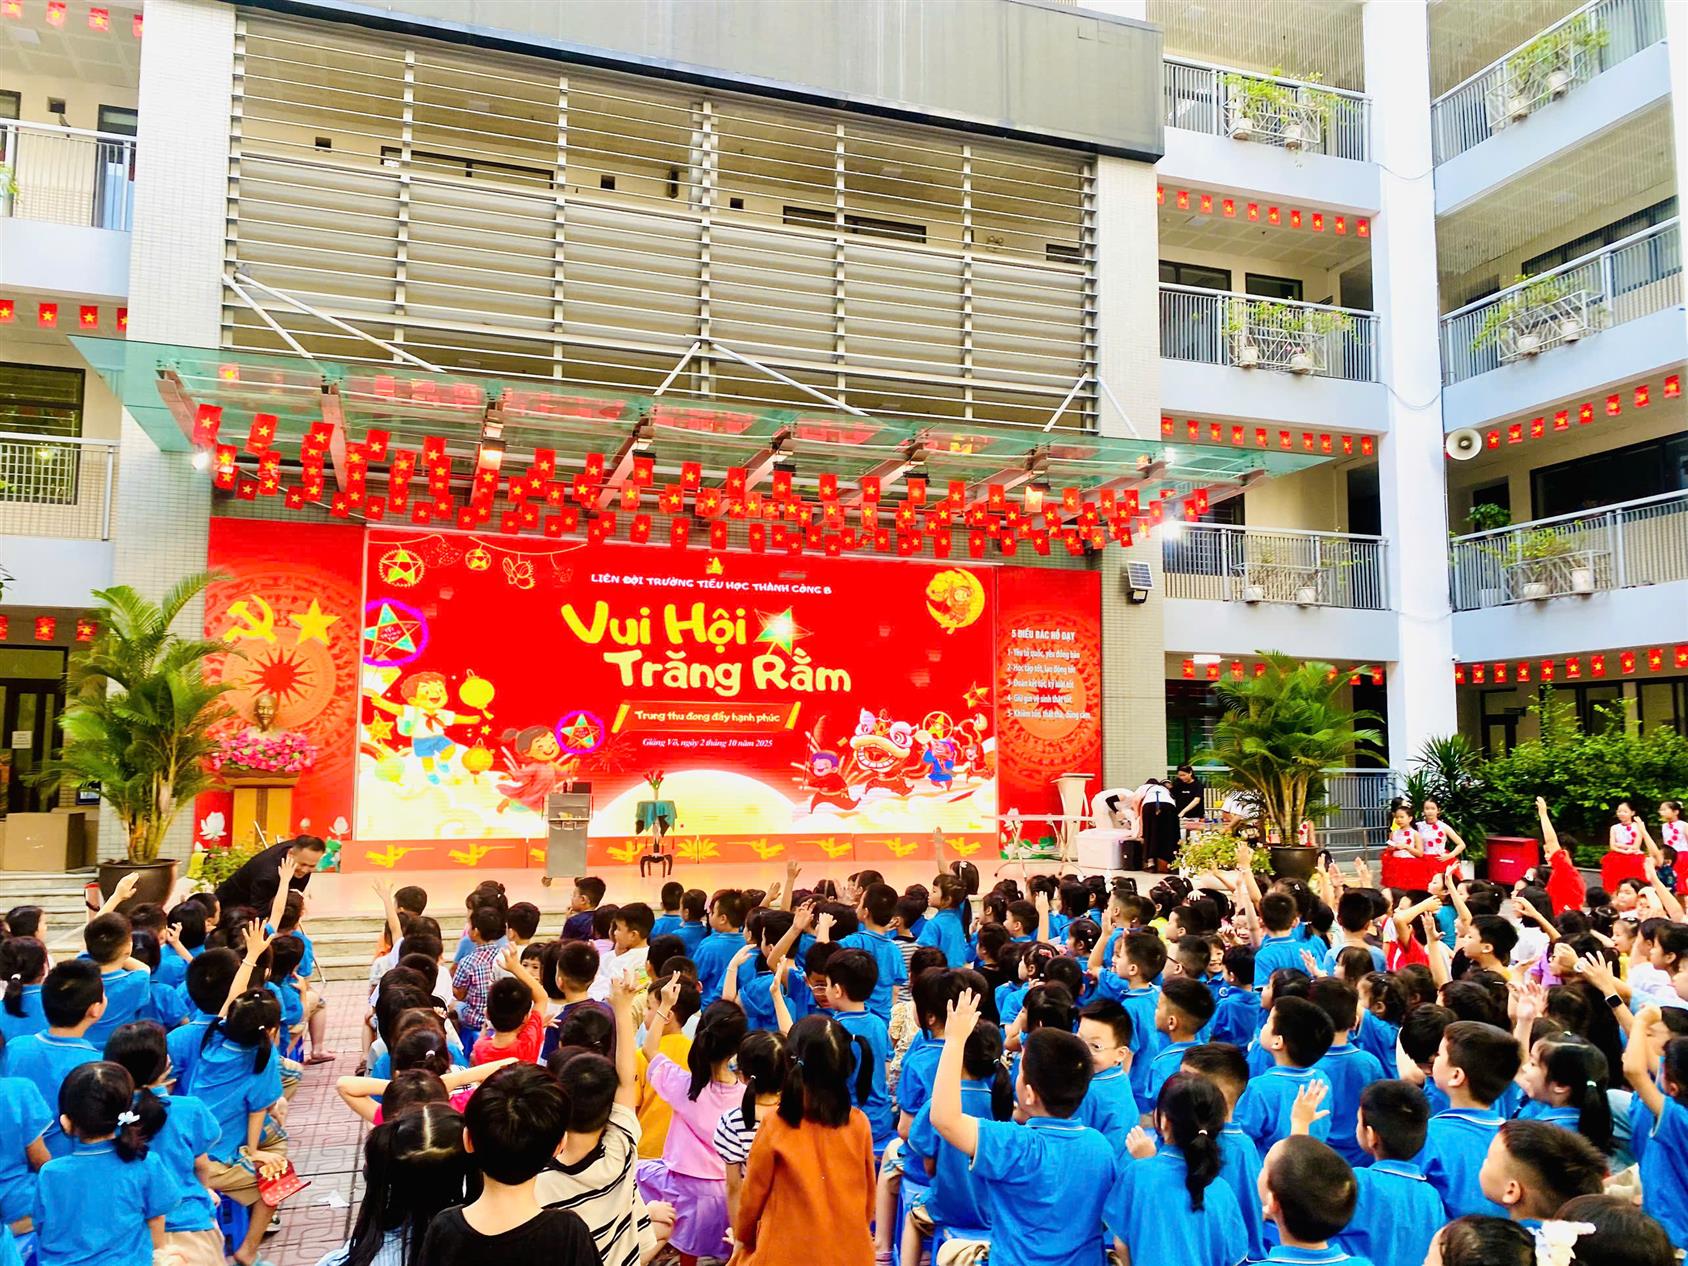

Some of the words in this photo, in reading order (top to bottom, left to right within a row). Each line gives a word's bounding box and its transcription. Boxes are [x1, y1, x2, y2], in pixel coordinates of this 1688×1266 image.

[591, 573, 620, 584] LIÊN
[622, 574, 644, 586] ĐỘI
[646, 577, 694, 588] TRƯỜNG
[725, 581, 749, 591] HỌC
[752, 582, 789, 593] THÀNH
[791, 584, 822, 594] CÔNG
[823, 586, 832, 595] B
[560, 600, 651, 646] Vui
[664, 601, 747, 654] Hội
[1011, 629, 1017, 638] 5
[603, 649, 742, 697] Trăng
[751, 647, 852, 692] Rằm
[634, 710, 666, 722] Trung
[667, 711, 684, 721] thu
[731, 712, 755, 724] hạnh
[756, 712, 780, 724] phúc
[680, 739, 699, 749] ngày
[700, 739, 706, 747] 2
[706, 738, 727, 749] tháng
[728, 739, 738, 747] 10
[738, 739, 754, 747] năm
[755, 739, 773, 748] 2025
